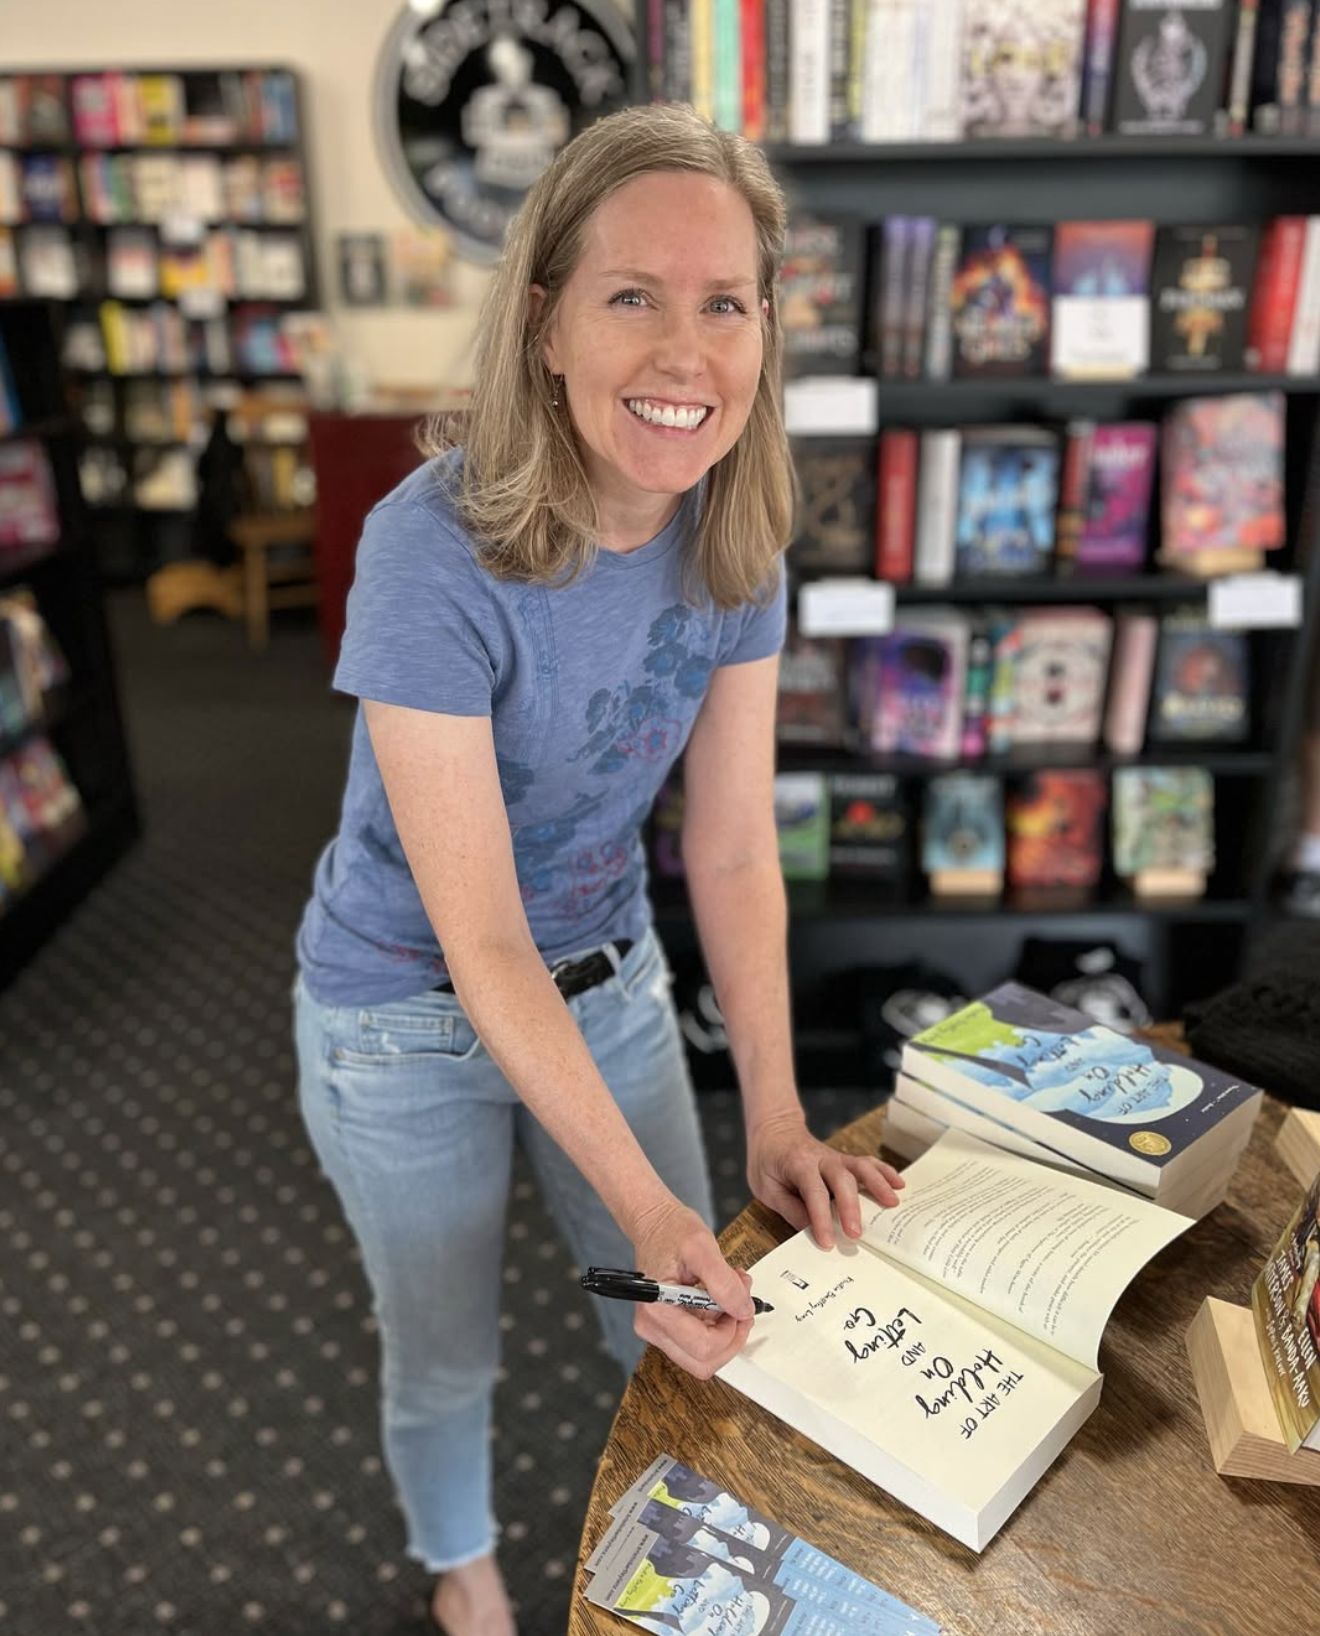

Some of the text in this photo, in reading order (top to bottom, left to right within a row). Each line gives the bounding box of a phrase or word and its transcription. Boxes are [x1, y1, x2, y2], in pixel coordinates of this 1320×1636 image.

[1275, 1249, 1295, 1292] JAMES
[844, 1308, 875, 1329] Go
[845, 1308, 921, 1362] Letting
[1278, 1309, 1290, 1331] &
[902, 1343, 924, 1366] AND
[921, 1357, 953, 1379] On
[1280, 1323, 1310, 1408] BANDA-AAKU
[1297, 1326, 1318, 1371] ELLEN
[916, 1350, 1003, 1417] Holding
[962, 1372, 1023, 1439] THE ART OF
